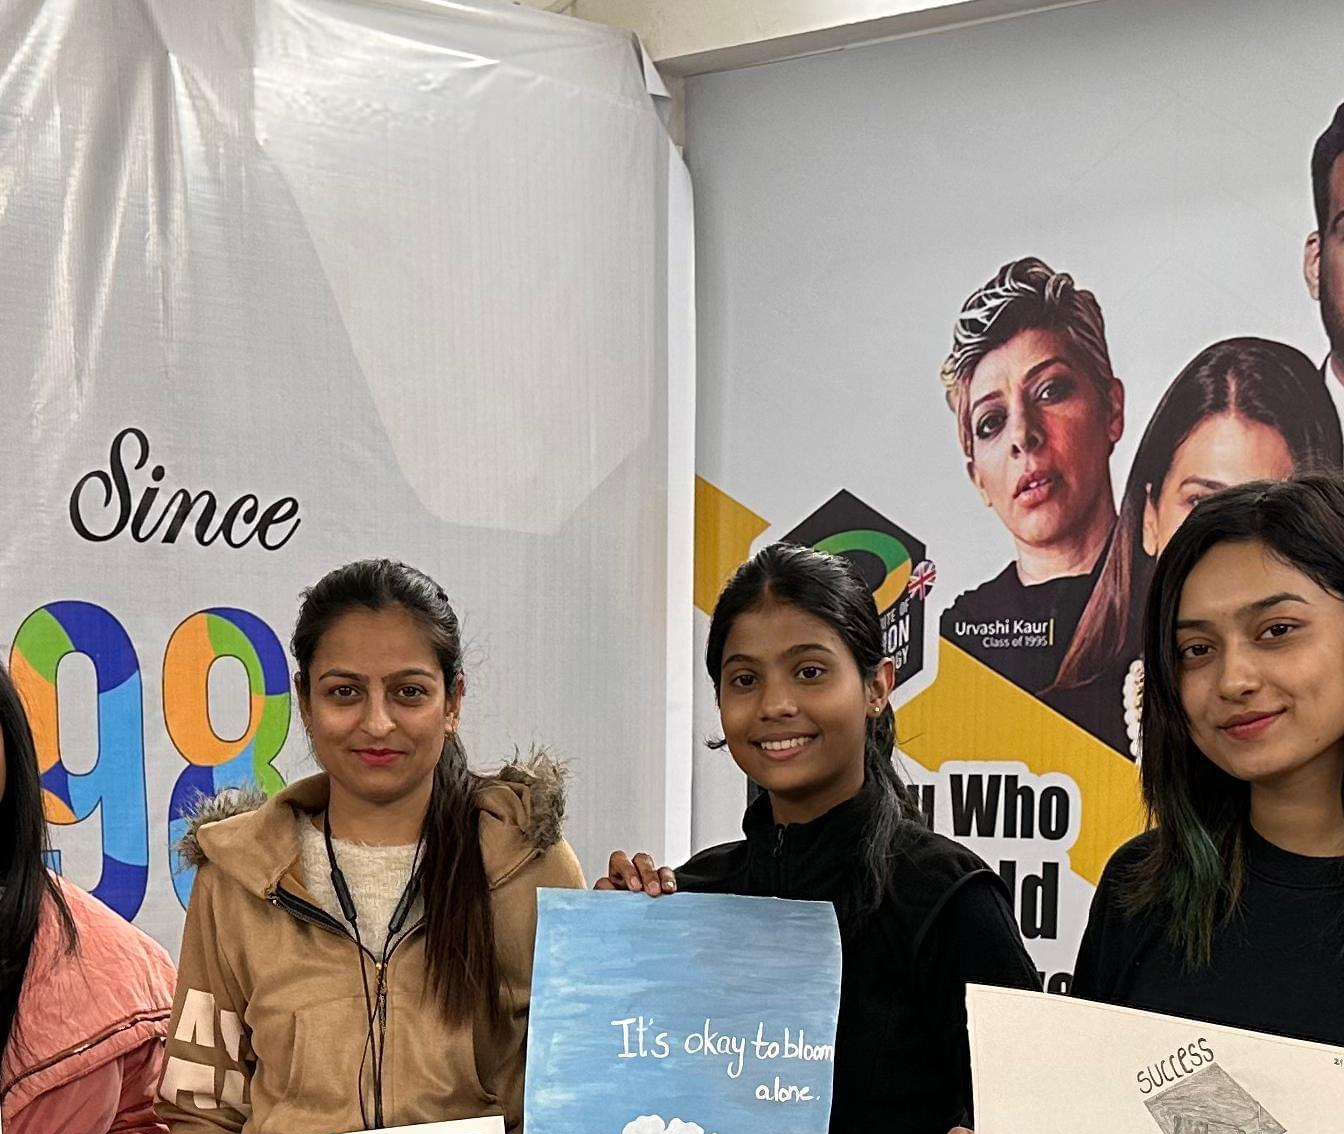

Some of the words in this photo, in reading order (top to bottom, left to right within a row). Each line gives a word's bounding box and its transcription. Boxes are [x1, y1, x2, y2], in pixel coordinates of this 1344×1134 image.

[69, 427, 301, 551] Since
[955, 619, 1010, 636] Urvashi
[1013, 619, 1049, 634] Kaur
[982, 636, 1010, 648] Class
[1011, 635, 1023, 647] of
[949, 774, 1070, 840] Who
[610, 1015, 670, 1059] It's
[683, 1018, 746, 1078] okay
[751, 1021, 779, 1060] to
[782, 1027, 834, 1062] bloom
[755, 1077, 821, 1103] alone.
